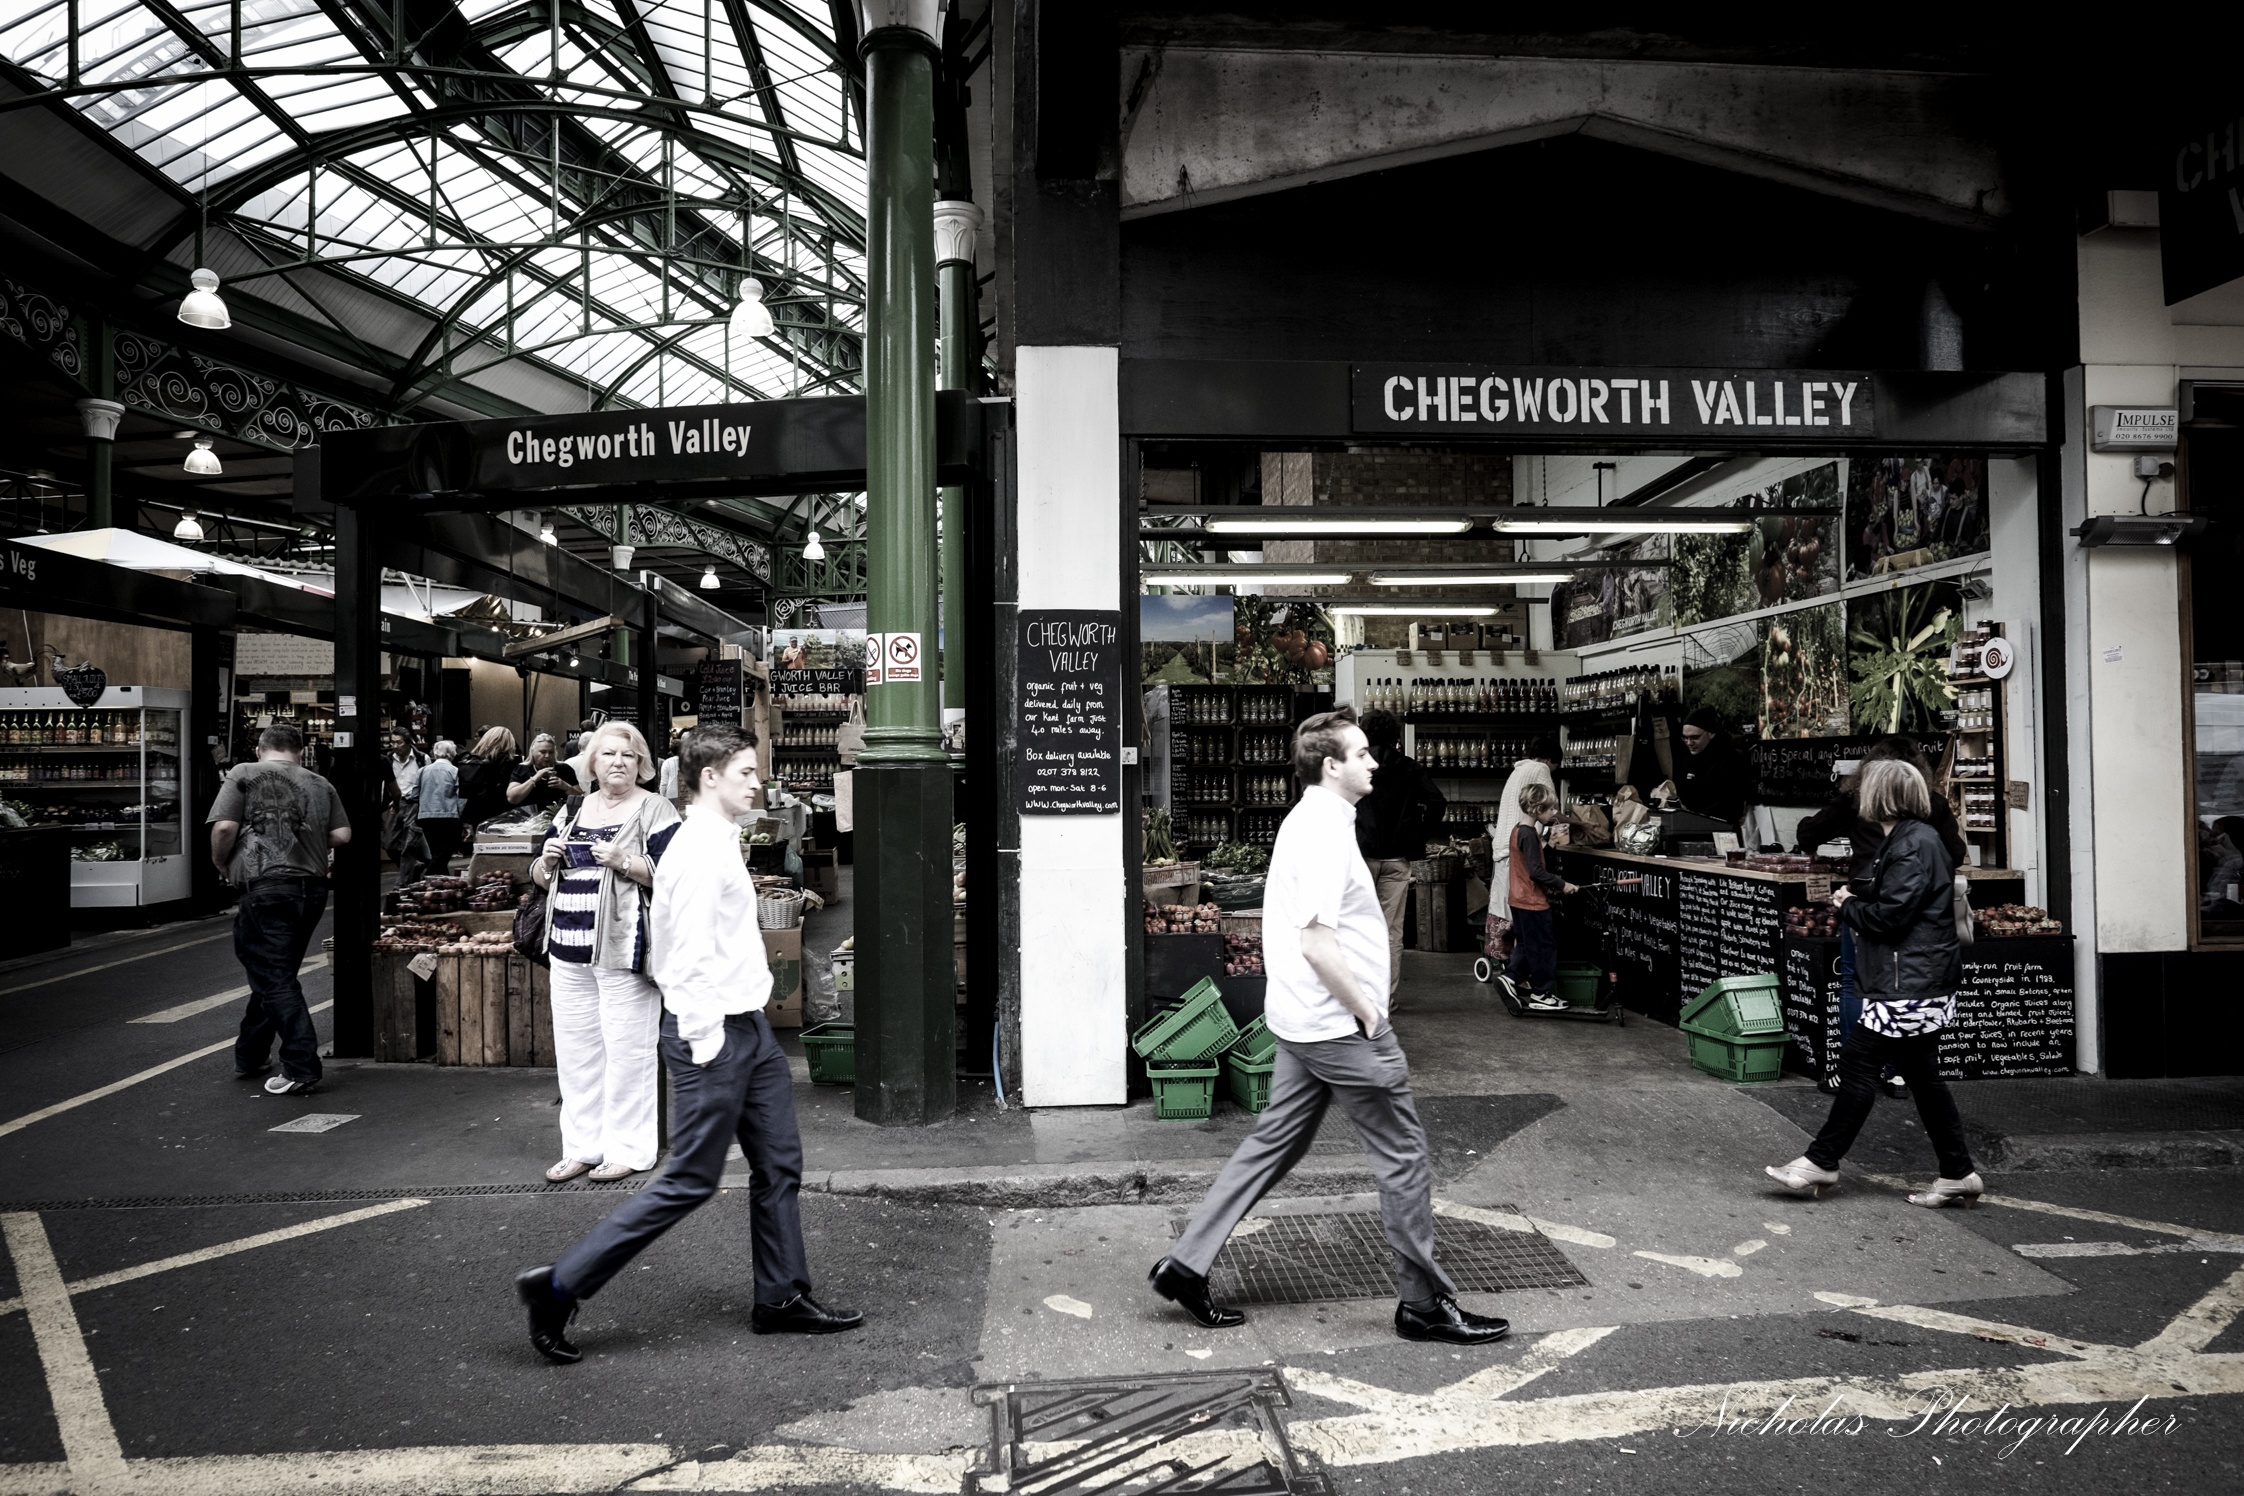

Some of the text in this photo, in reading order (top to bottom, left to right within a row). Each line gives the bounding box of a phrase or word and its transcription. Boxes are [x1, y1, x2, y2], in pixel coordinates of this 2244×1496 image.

[1384, 375, 1857, 426] CHEGWORTH VALLEY
[2116, 412, 2176, 427] IMPULSE
[507, 418, 751, 468] Chegworth Valley
[10, 550, 36, 580] Veg
[1027, 622, 1116, 648] CHEGWORTH
[1049, 650, 1098, 672] VALLEY
[700, 664, 734, 674] Cold Juice
[770, 670, 810, 681] GWORTH
[815, 670, 854, 681] VALLEY
[781, 683, 813, 692] JUICE
[819, 683, 840, 692] BAR
[1026, 682, 1056, 696] organic
[1061, 681, 1078, 694] fruit
[1090, 682, 1102, 696] veg
[1024, 698, 1104, 714] delivered daily from
[1043, 712, 1059, 722] Kent
[1066, 714, 1084, 724] farm
[1031, 724, 1045, 736] 40
[1051, 725, 1072, 734] miles
[1026, 748, 1111, 767] Box delivery available
[1818, 750, 1832, 766] any
[1834, 744, 1840, 757] 2
[1037, 768, 1100, 777] 0207 378 8122
[1028, 785, 1047, 795] open
[1790, 949, 1811, 962] organic
[2004, 962, 2022, 973] fruit
[2024, 963, 2043, 974] farm
[1972, 976, 2015, 987] Countryside
[2021, 974, 2031, 982] in
[1799, 980, 1816, 999] Delivery
[1991, 1000, 2020, 1011] Organic
[2052, 999, 2073, 1010] along
[1978, 1010, 1994, 1018] and
[2028, 1009, 2045, 1018] fruit
[2008, 1028, 2016, 1038] in
[2050, 1029, 2073, 1039] years
[1938, 1042, 1970, 1054] pansion
